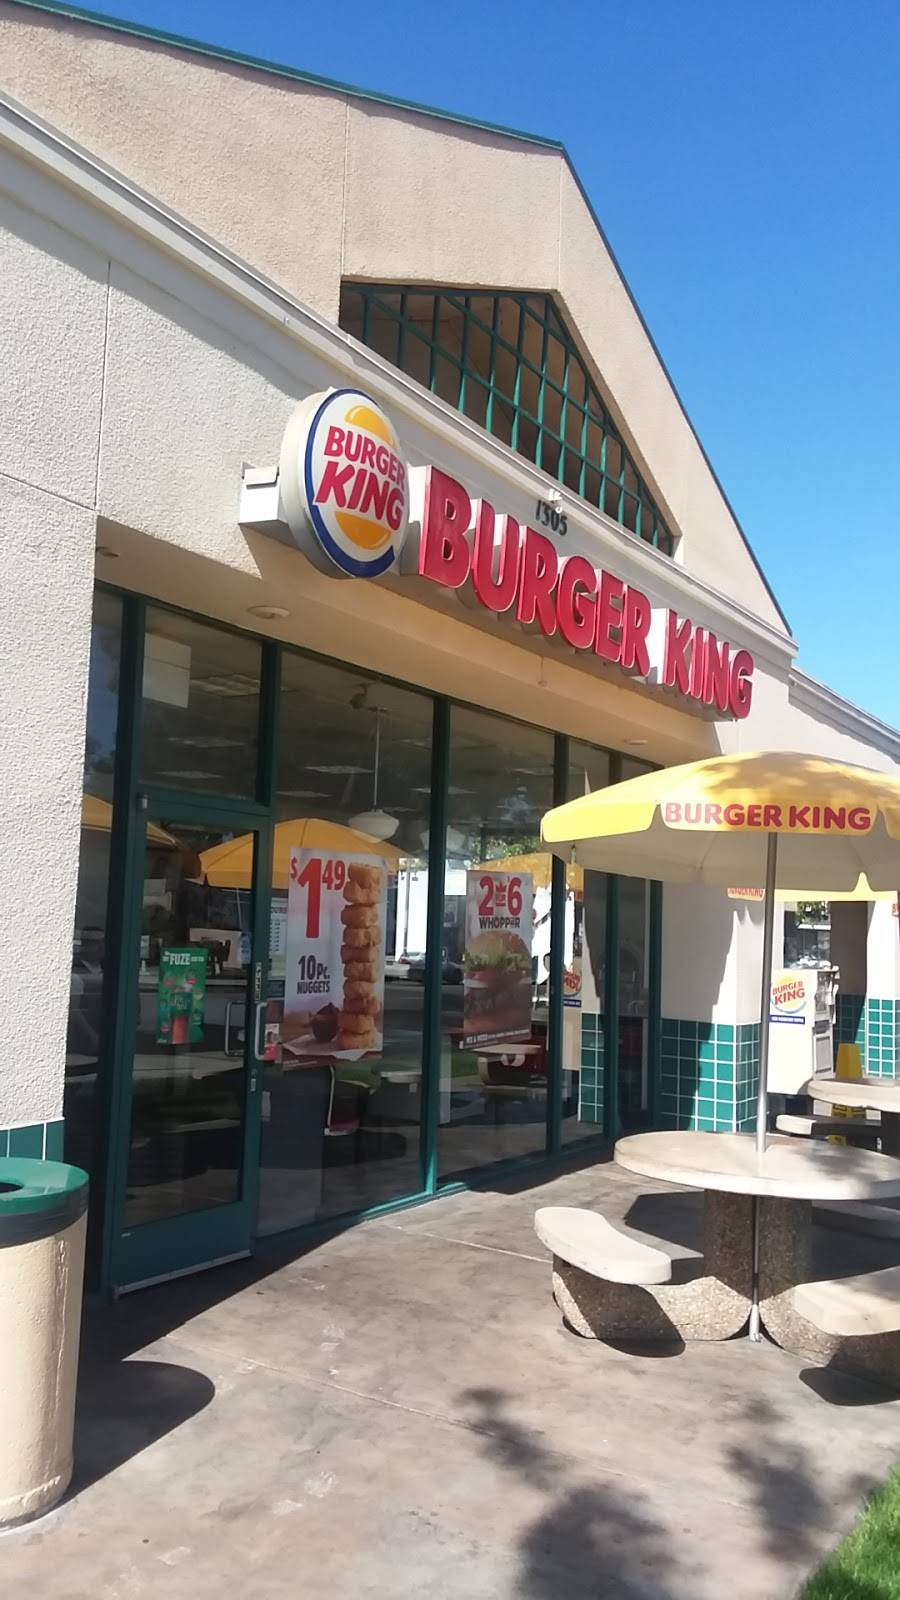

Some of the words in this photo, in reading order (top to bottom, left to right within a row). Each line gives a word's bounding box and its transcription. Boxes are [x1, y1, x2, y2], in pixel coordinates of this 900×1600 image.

[324, 425, 404, 491] BURGER
[315, 461, 404, 530] KING
[536, 500, 567, 535] 1305
[418, 465, 652, 677] BURGER
[663, 608, 754, 719] KING
[665, 802, 782, 827] BURGER
[789, 805, 871, 830] KING
[479, 876, 494, 916] 2
[479, 917, 521, 929] WHOPPER
[169, 953, 191, 966] FUZE
[298, 955, 316, 980] 10
[297, 981, 331, 995] NUGGETS
[772, 981, 804, 996] BURGER
[775, 988, 805, 1005] KING
